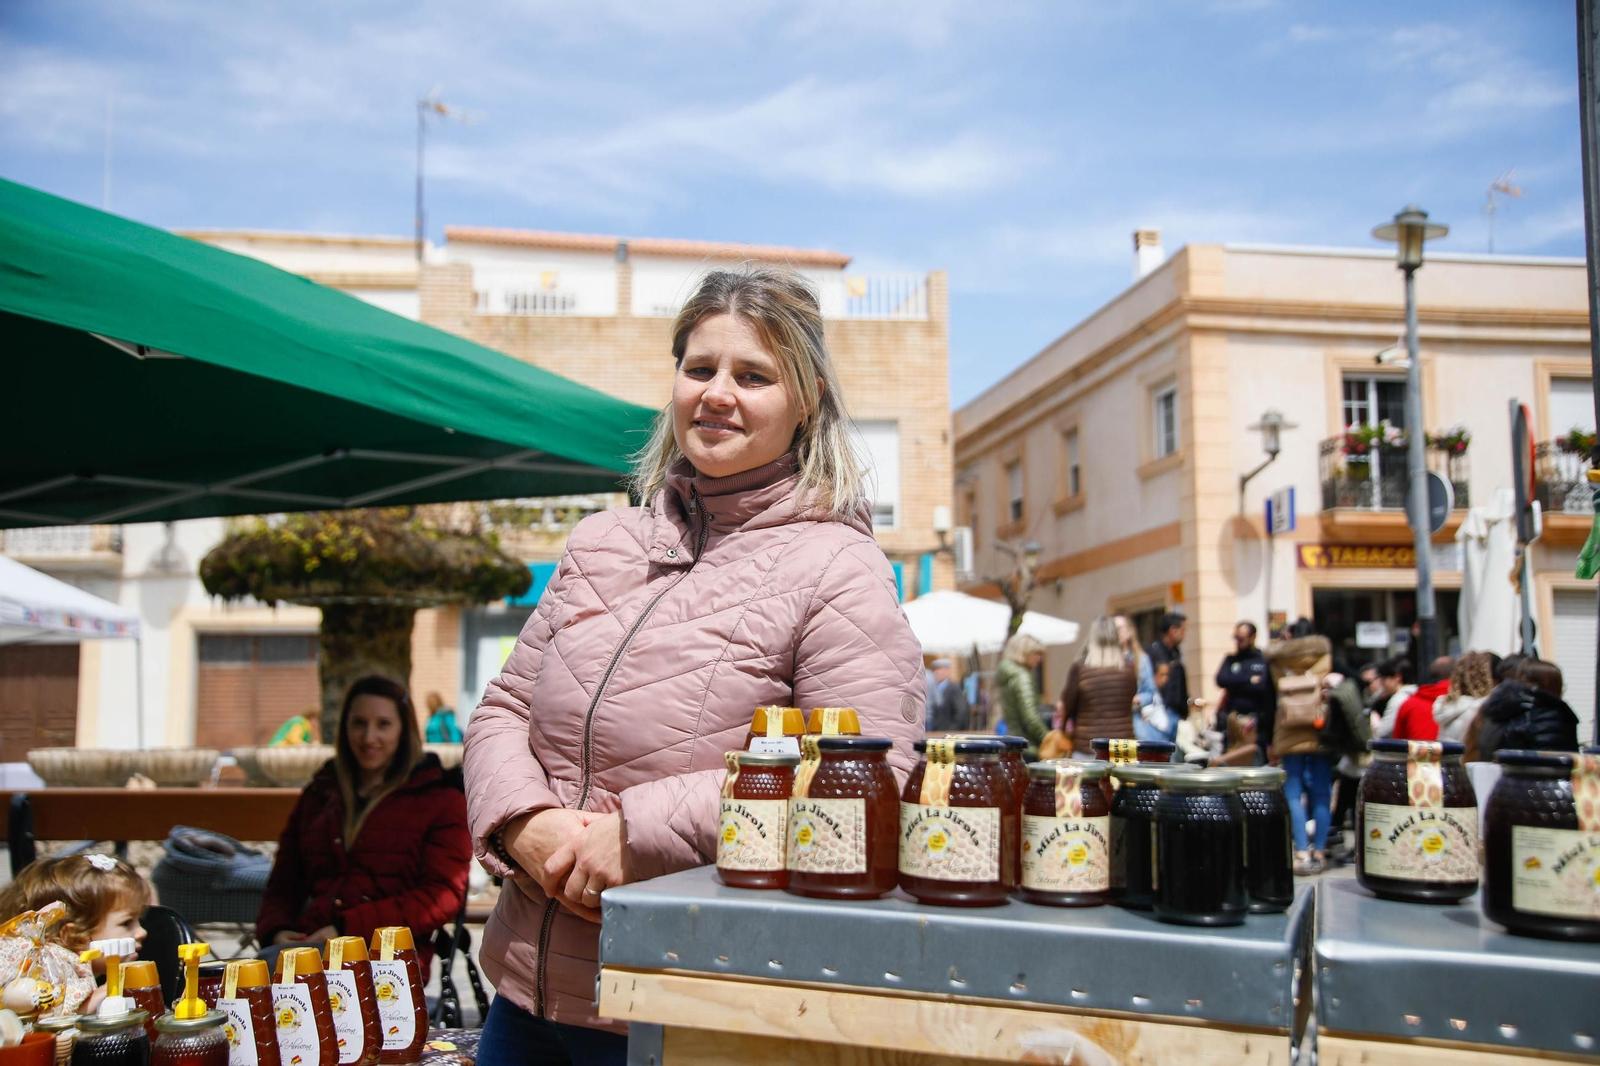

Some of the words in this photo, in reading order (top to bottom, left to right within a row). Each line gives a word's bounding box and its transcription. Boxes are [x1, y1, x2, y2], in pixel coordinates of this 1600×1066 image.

[722, 803, 732, 812] La
[734, 804, 767, 839] Jirola
[796, 803, 806, 812] La
[809, 804, 842, 839] Jirola
[905, 812, 923, 841] Miel
[925, 808, 940, 818] La
[944, 809, 979, 846] Jirola
[1387, 815, 1415, 844] Miel
[1418, 810, 1436, 821] La
[1036, 826, 1061, 857] Miel
[1063, 822, 1080, 833] La
